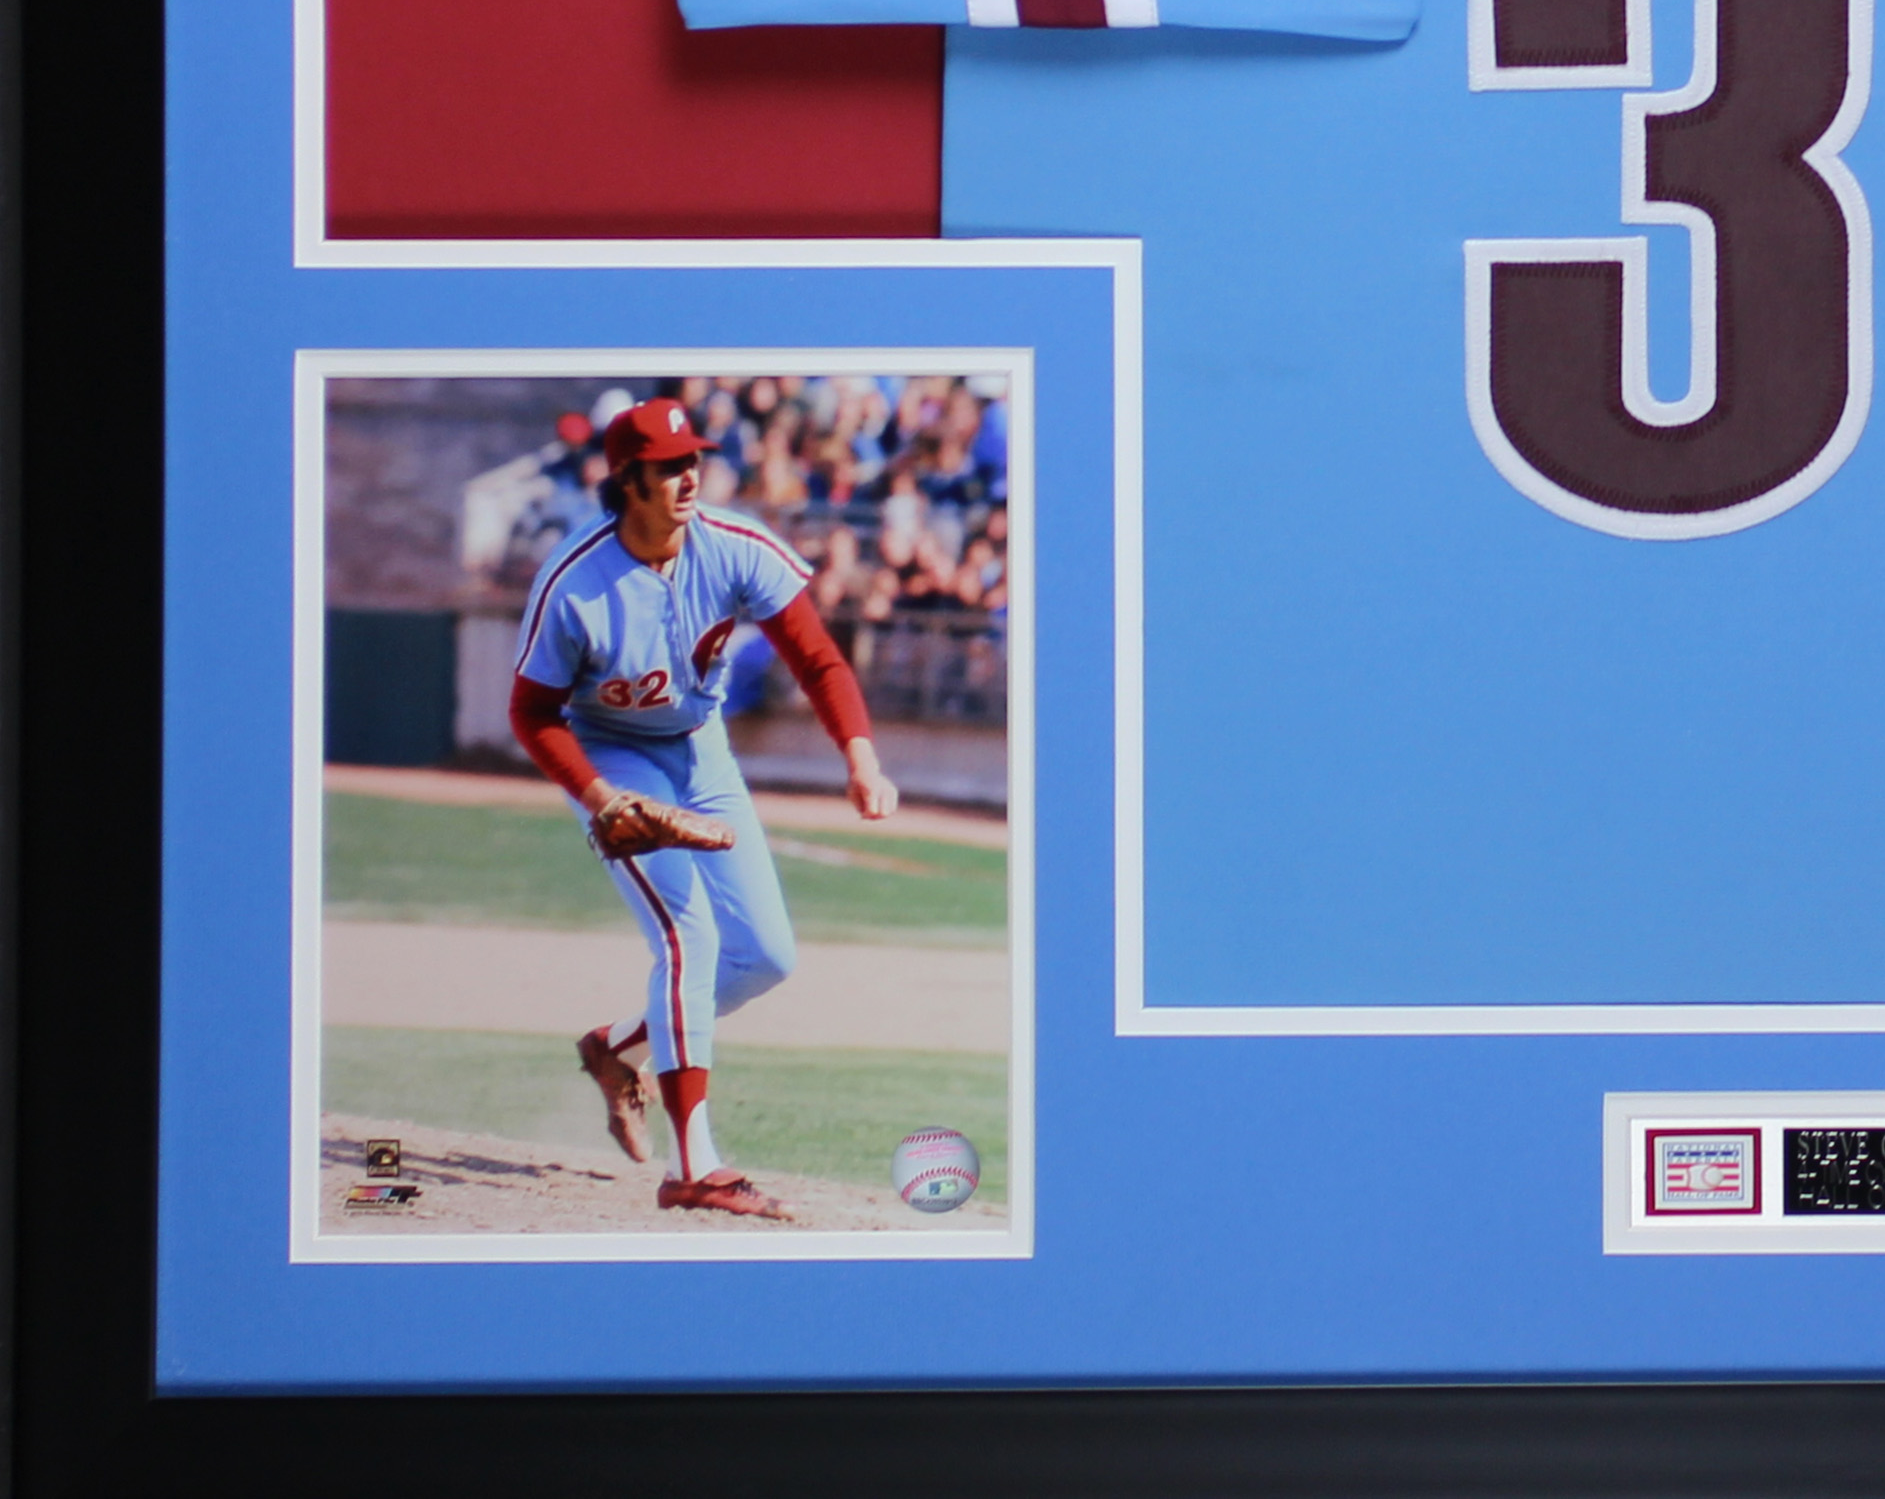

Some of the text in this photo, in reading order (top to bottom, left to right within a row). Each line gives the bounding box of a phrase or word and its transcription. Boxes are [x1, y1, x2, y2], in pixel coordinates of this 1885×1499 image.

[598, 669, 672, 710] 32
[1797, 1131, 1869, 1160] STEVE
[1798, 1184, 1859, 1210] HALL
